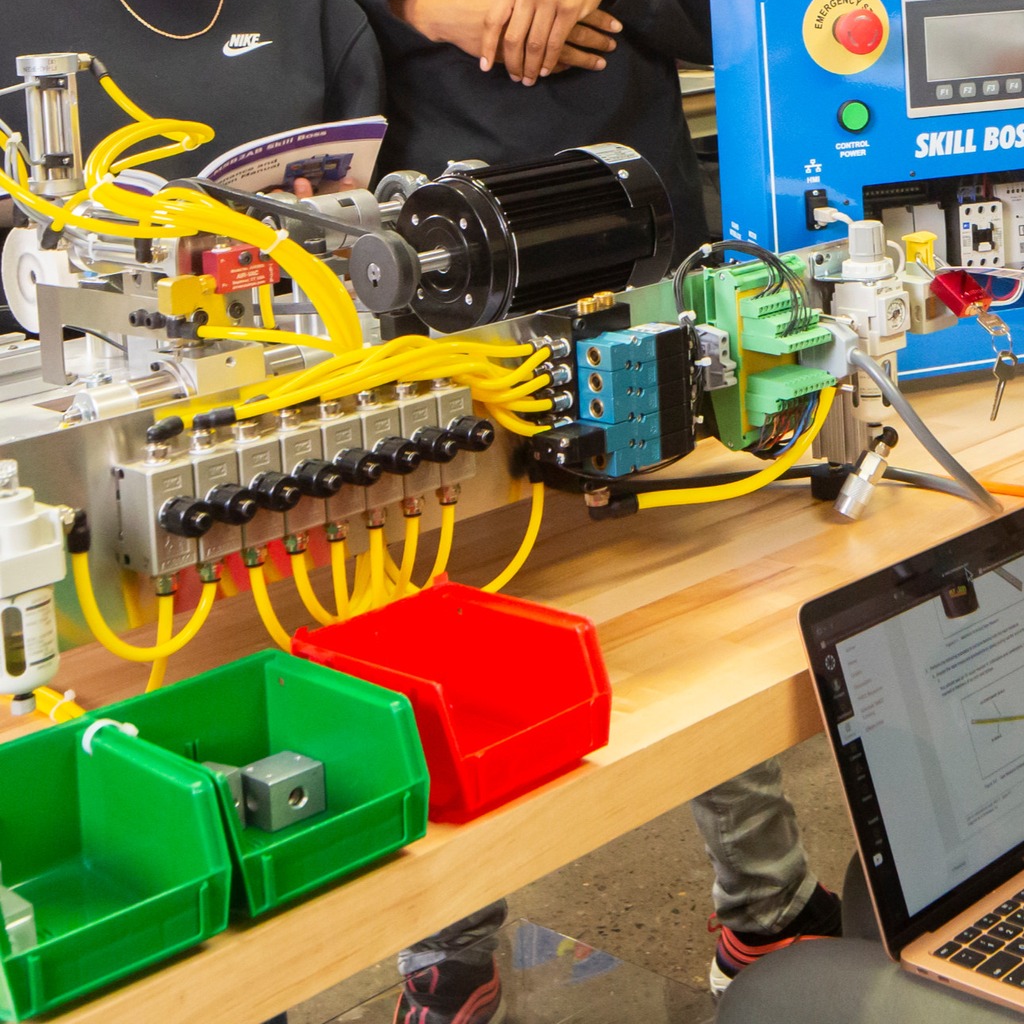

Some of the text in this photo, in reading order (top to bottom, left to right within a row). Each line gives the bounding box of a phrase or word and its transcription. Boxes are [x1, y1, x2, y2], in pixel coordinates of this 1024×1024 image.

[229, 33, 261, 47] NIKE
[963, 86, 973, 94] F2
[986, 84, 996, 92] F3
[1009, 82, 1019, 90] F4
[266, 137, 294, 150] Skill
[297, 130, 328, 142] Boss
[835, 140, 870, 150] CONTROL
[914, 128, 977, 158] SKILL
[839, 149, 867, 158] POWER
[806, 176, 820, 184] HMI
